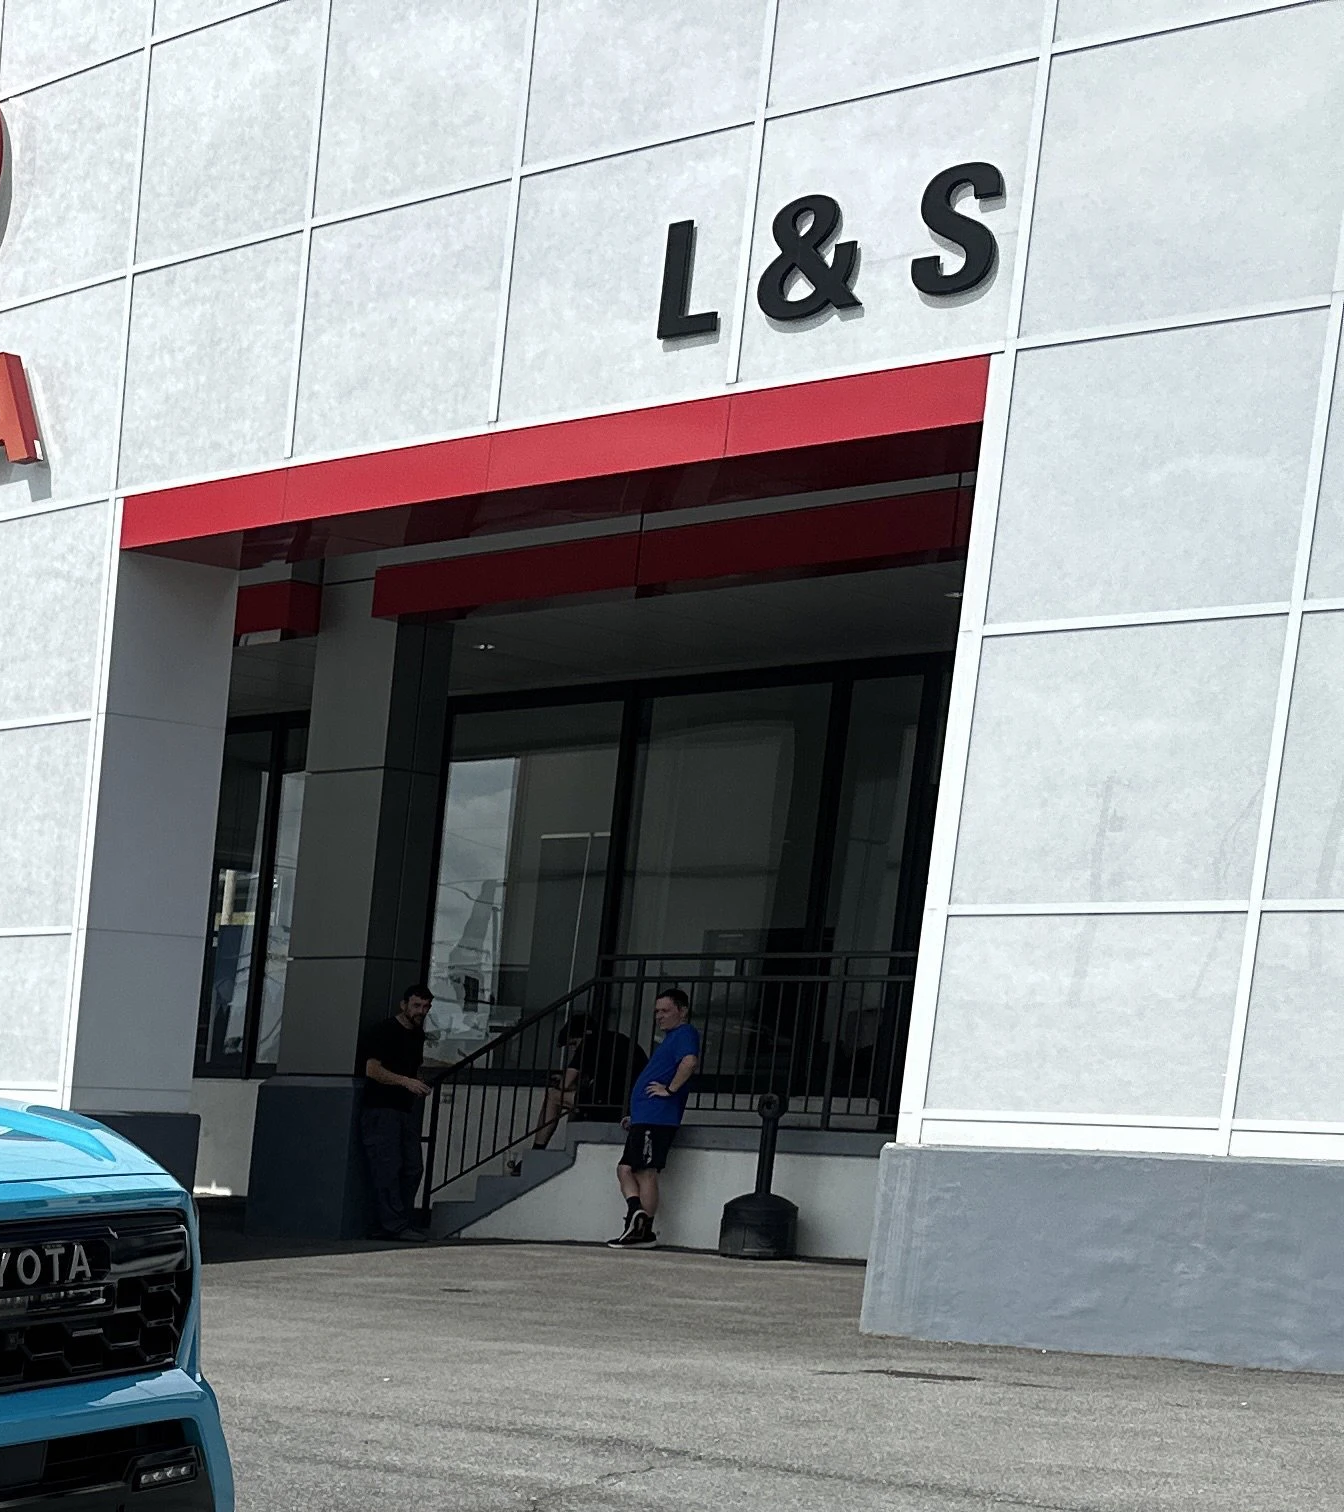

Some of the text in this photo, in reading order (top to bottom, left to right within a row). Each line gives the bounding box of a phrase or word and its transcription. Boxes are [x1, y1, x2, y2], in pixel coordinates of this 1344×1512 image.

[657, 161, 1005, 340] L & S
